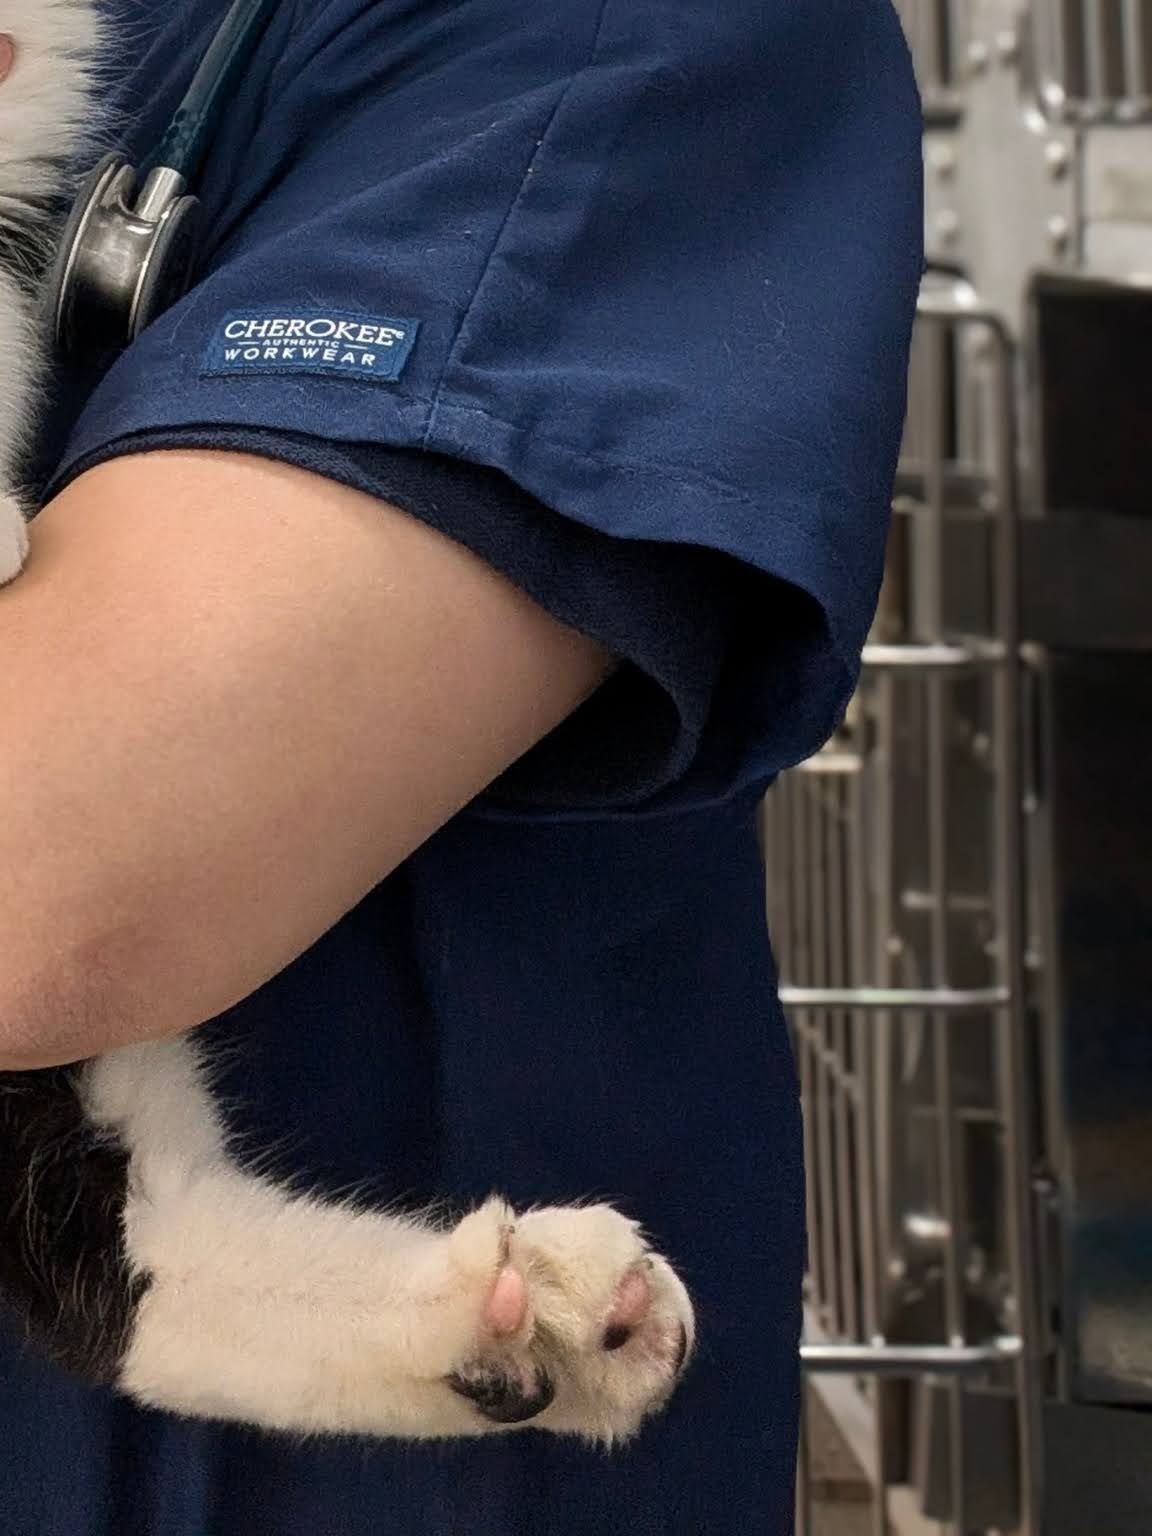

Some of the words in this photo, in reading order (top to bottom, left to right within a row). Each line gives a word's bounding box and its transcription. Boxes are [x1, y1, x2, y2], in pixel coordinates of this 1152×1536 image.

[224, 318, 397, 346] CHEROKEE
[262, 338, 339, 349] AUTHENTIC
[224, 347, 377, 366] WORKWEAR
